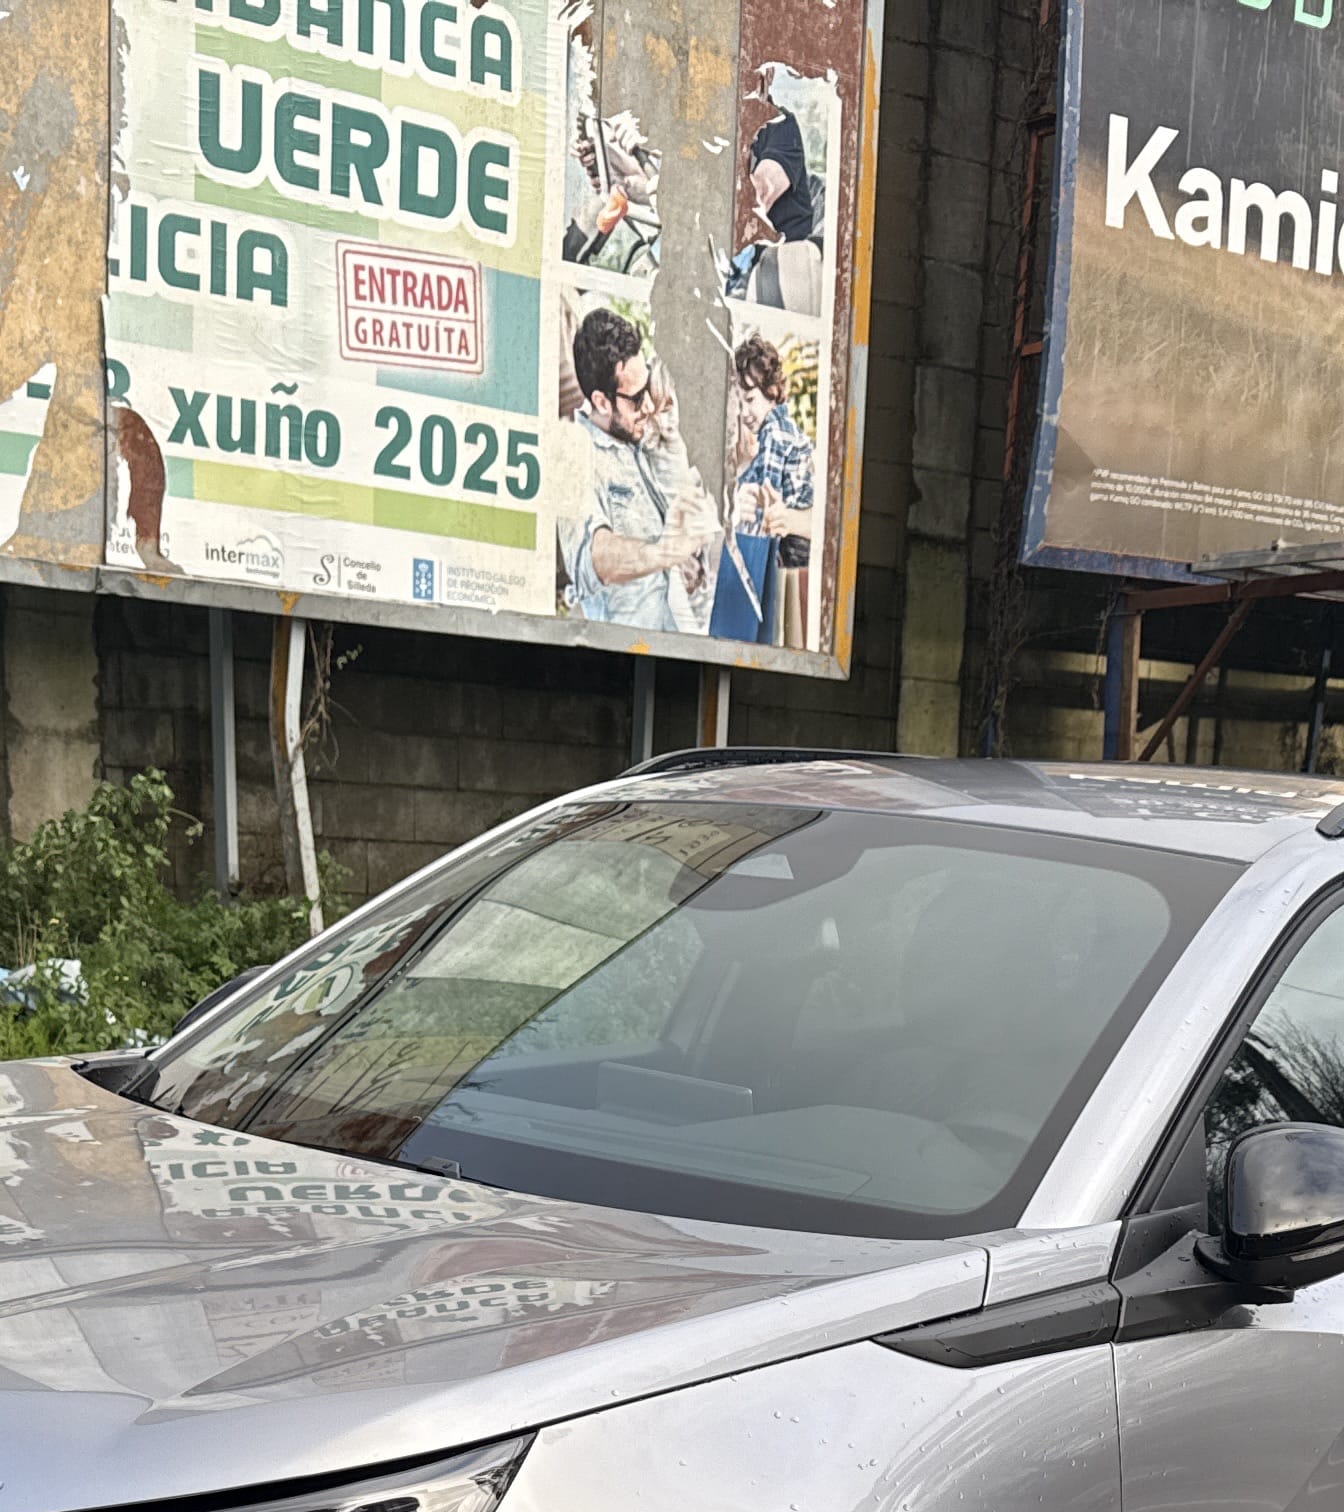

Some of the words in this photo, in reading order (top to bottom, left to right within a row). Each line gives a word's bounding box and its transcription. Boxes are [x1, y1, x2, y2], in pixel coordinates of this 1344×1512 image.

[353, 264, 469, 314] ENTRADA
[355, 316, 470, 357] GRATUÍTA
[167, 381, 341, 468] xuño
[374, 405, 541, 500] 2025
[206, 542, 280, 569] intermax
